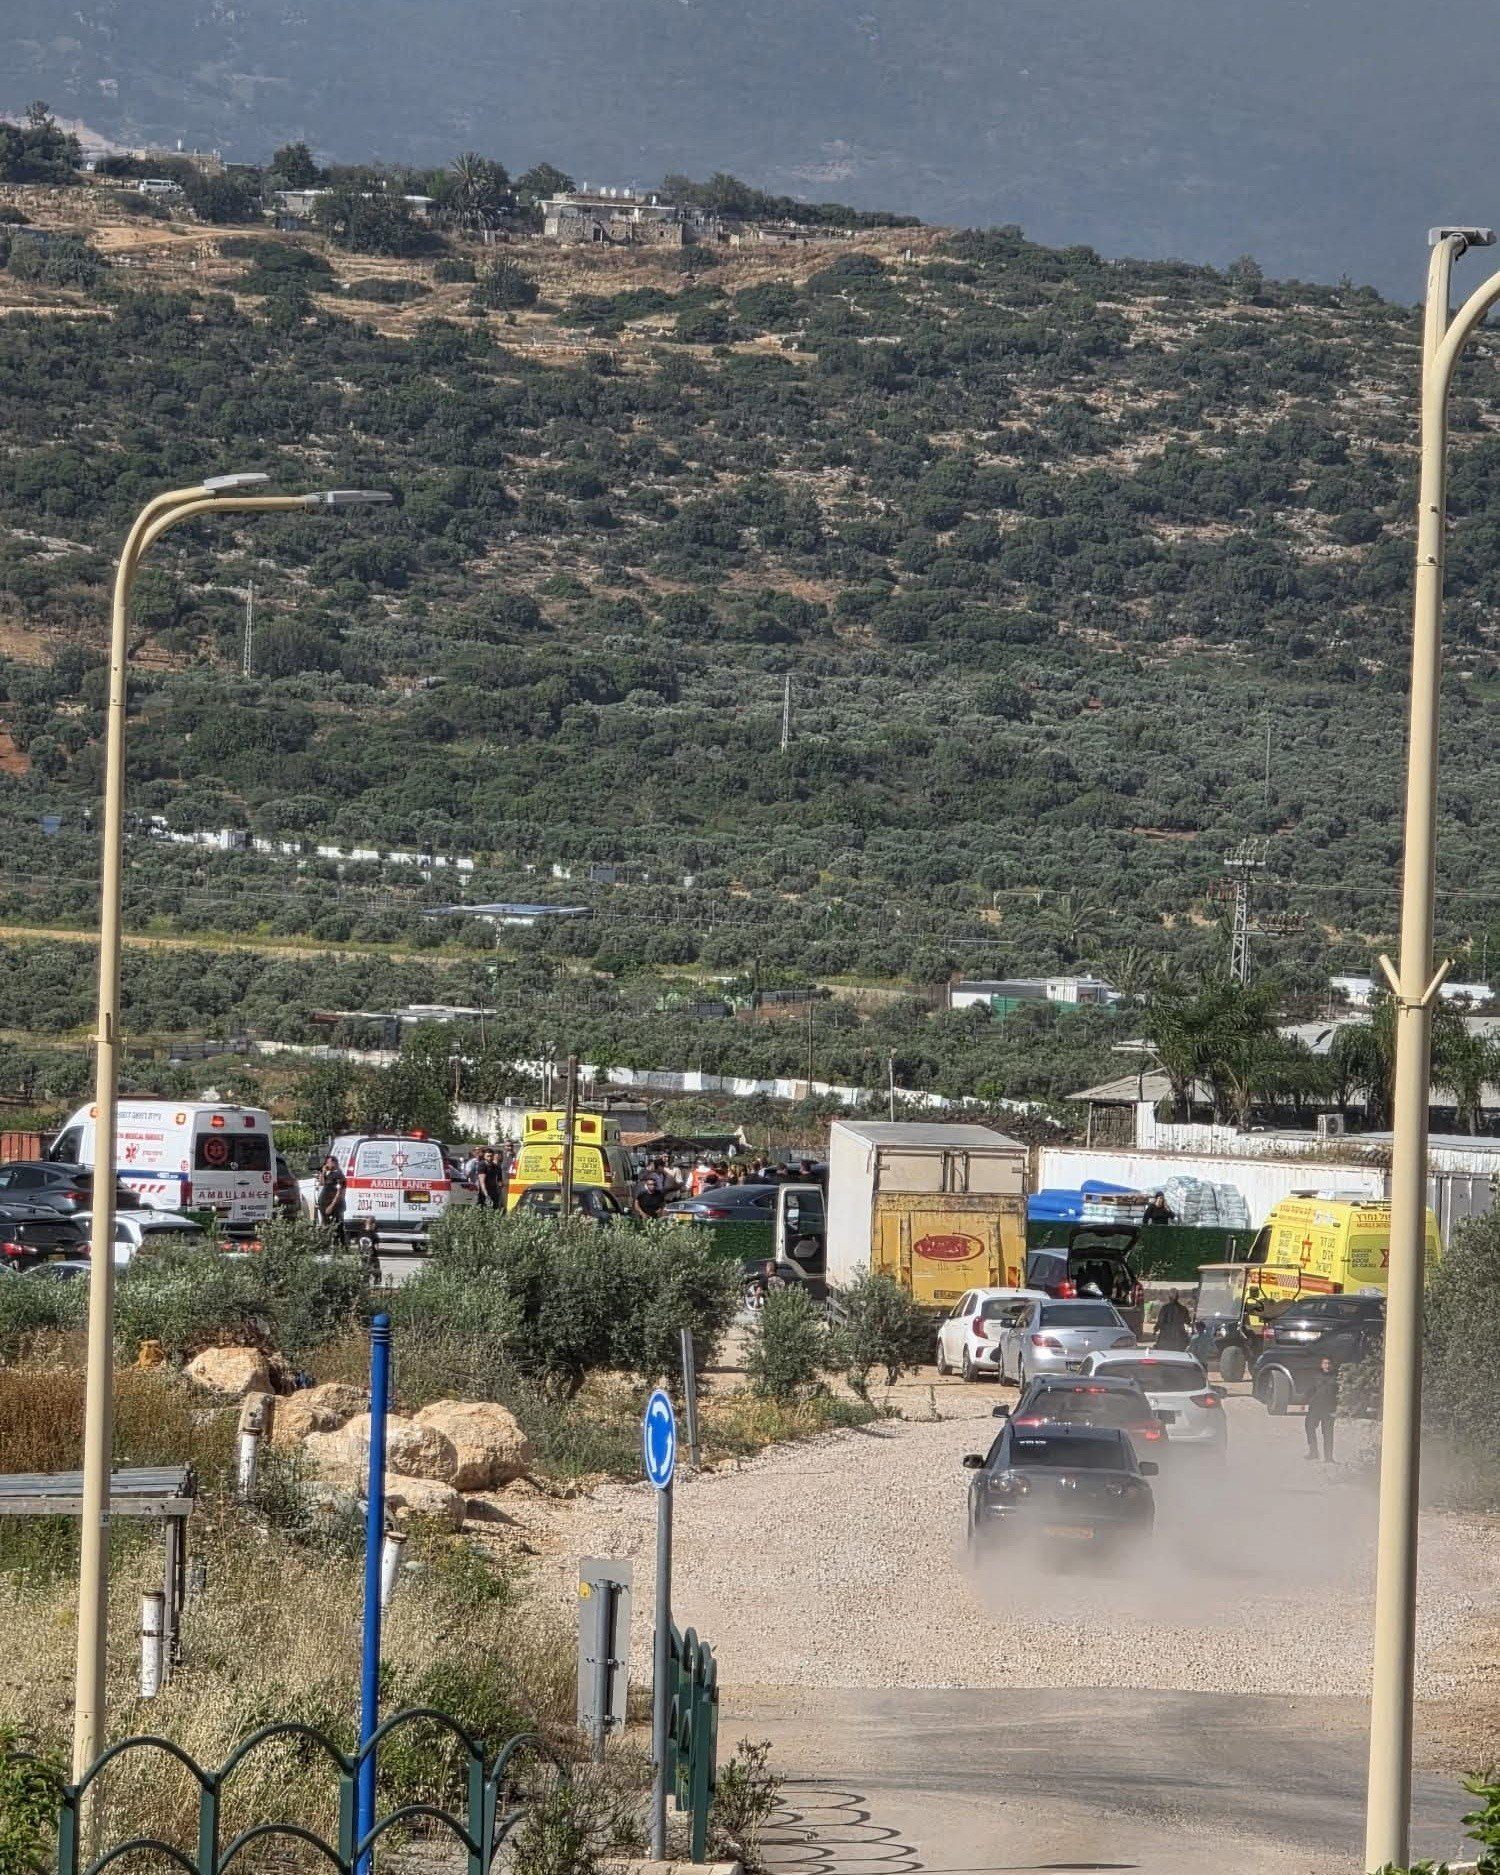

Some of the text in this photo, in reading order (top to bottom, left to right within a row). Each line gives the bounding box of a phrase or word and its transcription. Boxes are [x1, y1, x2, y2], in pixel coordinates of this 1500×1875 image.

[370, 1180, 432, 1190] AMBULANCE
[198, 1190, 270, 1199] AMBULANCE
[1356, 1213, 1377, 1222] נמרץ
